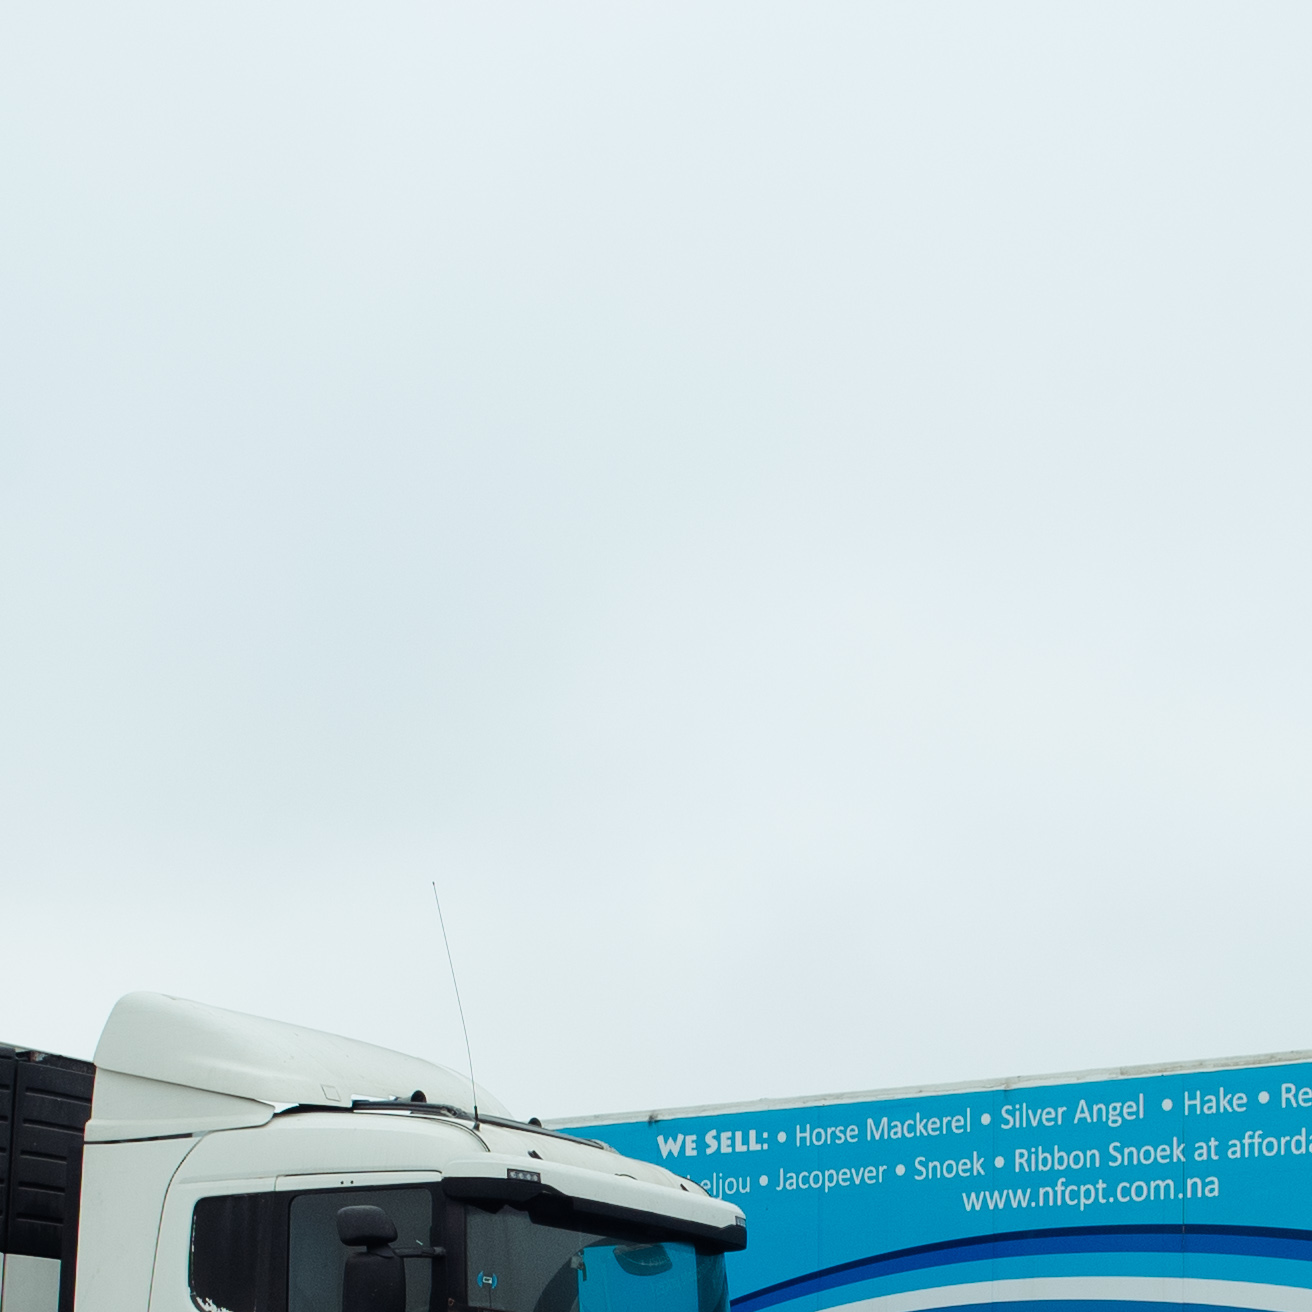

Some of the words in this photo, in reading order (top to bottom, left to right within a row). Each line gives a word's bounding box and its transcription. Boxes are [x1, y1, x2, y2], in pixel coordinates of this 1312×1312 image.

[656, 1133, 698, 1160] WE
[704, 1129, 769, 1155] SELL:
[796, 1123, 859, 1147] Horse
[866, 1107, 972, 1141] Mackerel
[1000, 1102, 1068, 1130] Silver
[1073, 1093, 1145, 1128] Angel
[1184, 1086, 1248, 1116] Hake
[686, 1171, 751, 1201] eljou
[775, 1165, 888, 1193] Jacopever
[914, 1150, 986, 1181] Snoek
[1014, 1144, 1100, 1173] Ribbon
[1108, 1136, 1187, 1167] Snoek
[1194, 1136, 1219, 1161] at
[961, 1176, 1220, 1213] www.nfcpt.com.na
